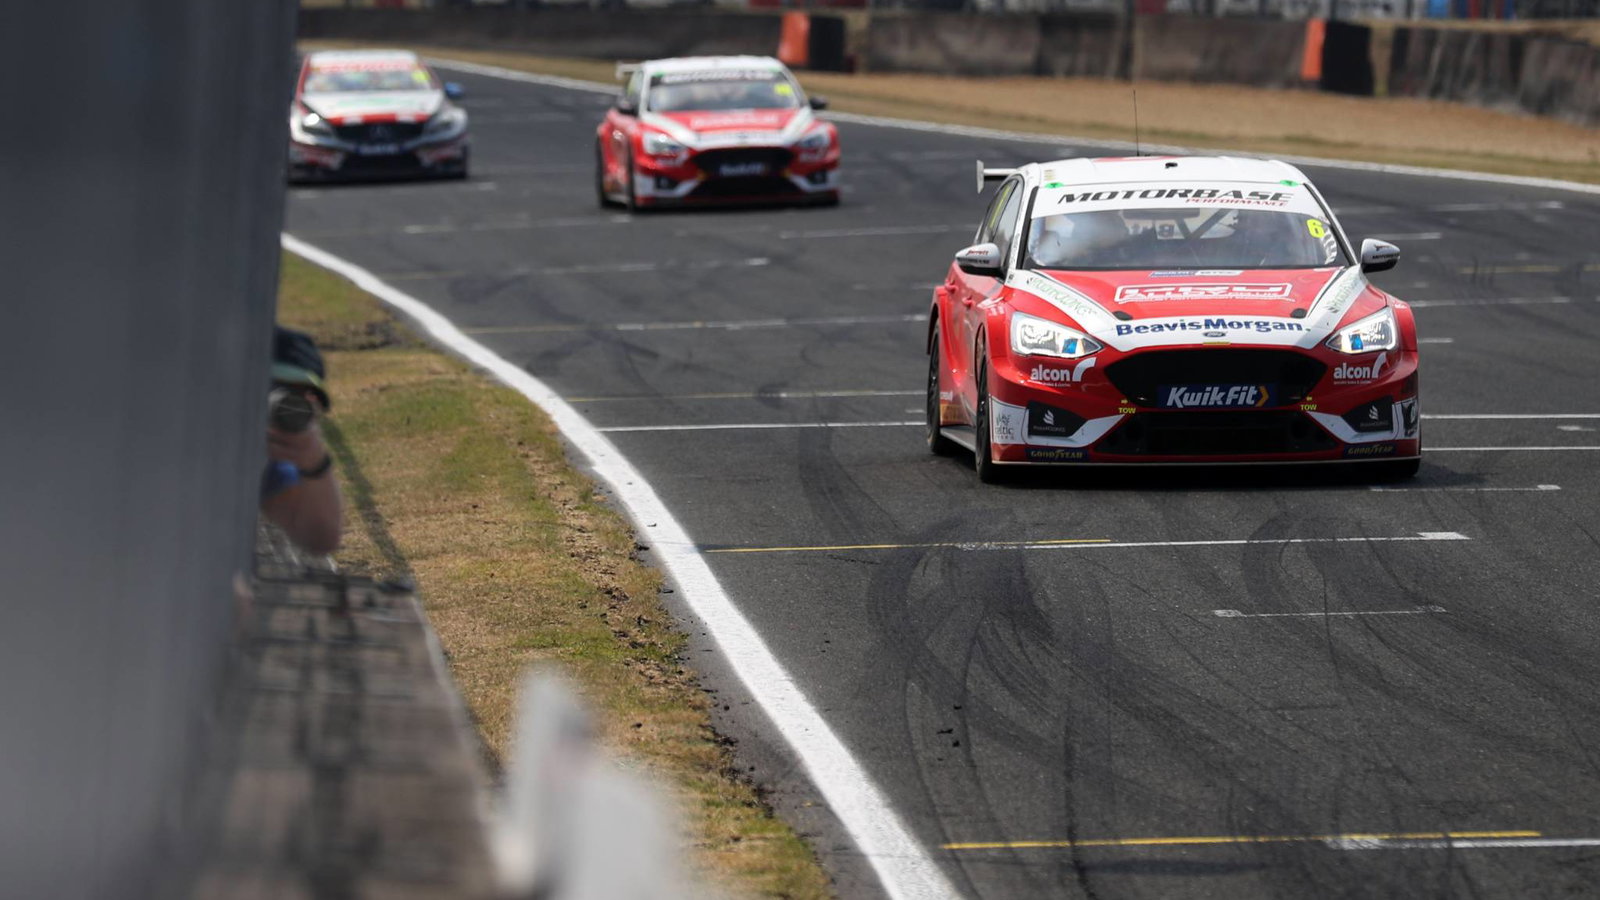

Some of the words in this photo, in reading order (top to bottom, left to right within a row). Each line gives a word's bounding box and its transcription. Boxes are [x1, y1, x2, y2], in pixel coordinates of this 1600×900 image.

[1058, 188, 1294, 204] MOTORBASE
[1306, 218, 1325, 239] 6
[1030, 364, 1071, 381] alcon
[1333, 362, 1371, 379] alcon
